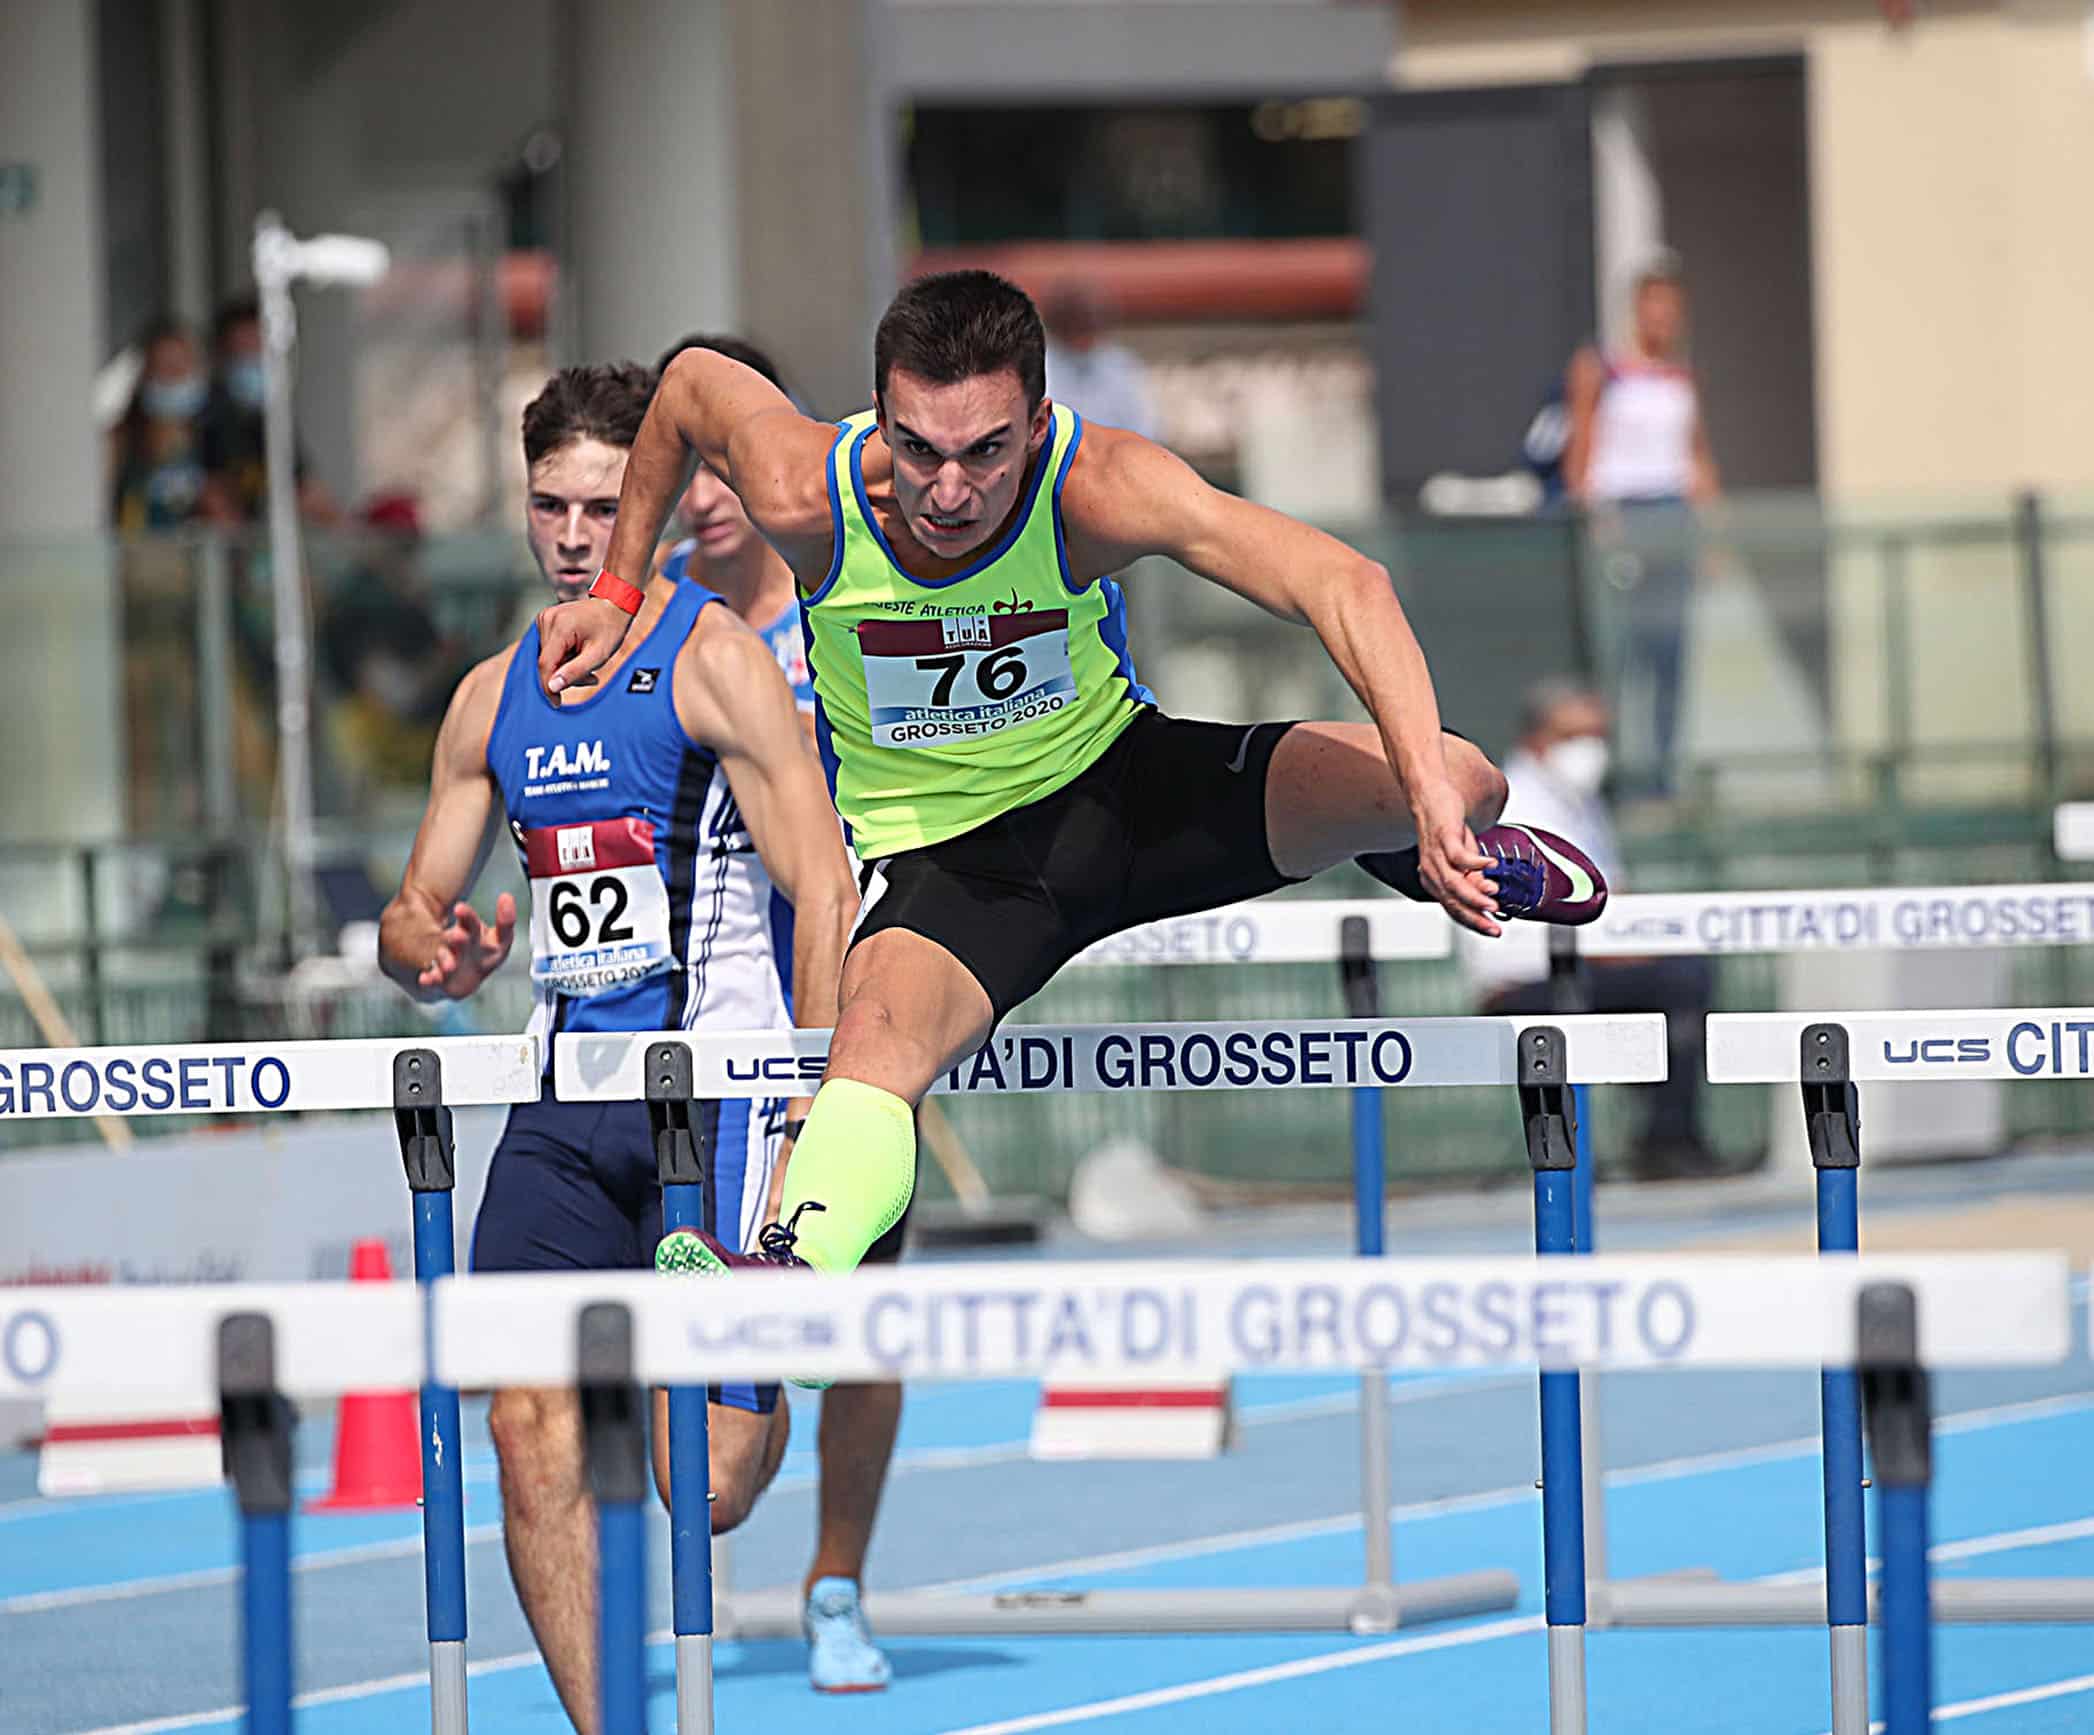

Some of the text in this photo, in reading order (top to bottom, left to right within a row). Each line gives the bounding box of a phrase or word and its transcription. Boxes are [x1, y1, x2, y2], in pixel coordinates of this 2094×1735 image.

[920, 604, 986, 617] ATLETICA
[945, 628, 989, 643] TUA
[915, 647, 1028, 707] 76
[891, 696, 1064, 742] GROSSETO 2020
[905, 686, 1046, 722] atletica italiana
[525, 740, 611, 780] T.A.M.
[549, 875, 634, 949] 62
[1095, 1030, 1412, 1088] GROSSETO
[1884, 1038, 1991, 1063] UCS
[863, 1286, 1198, 1367] CITTA'DI
[1229, 1278, 1697, 1363] GROSSETO
